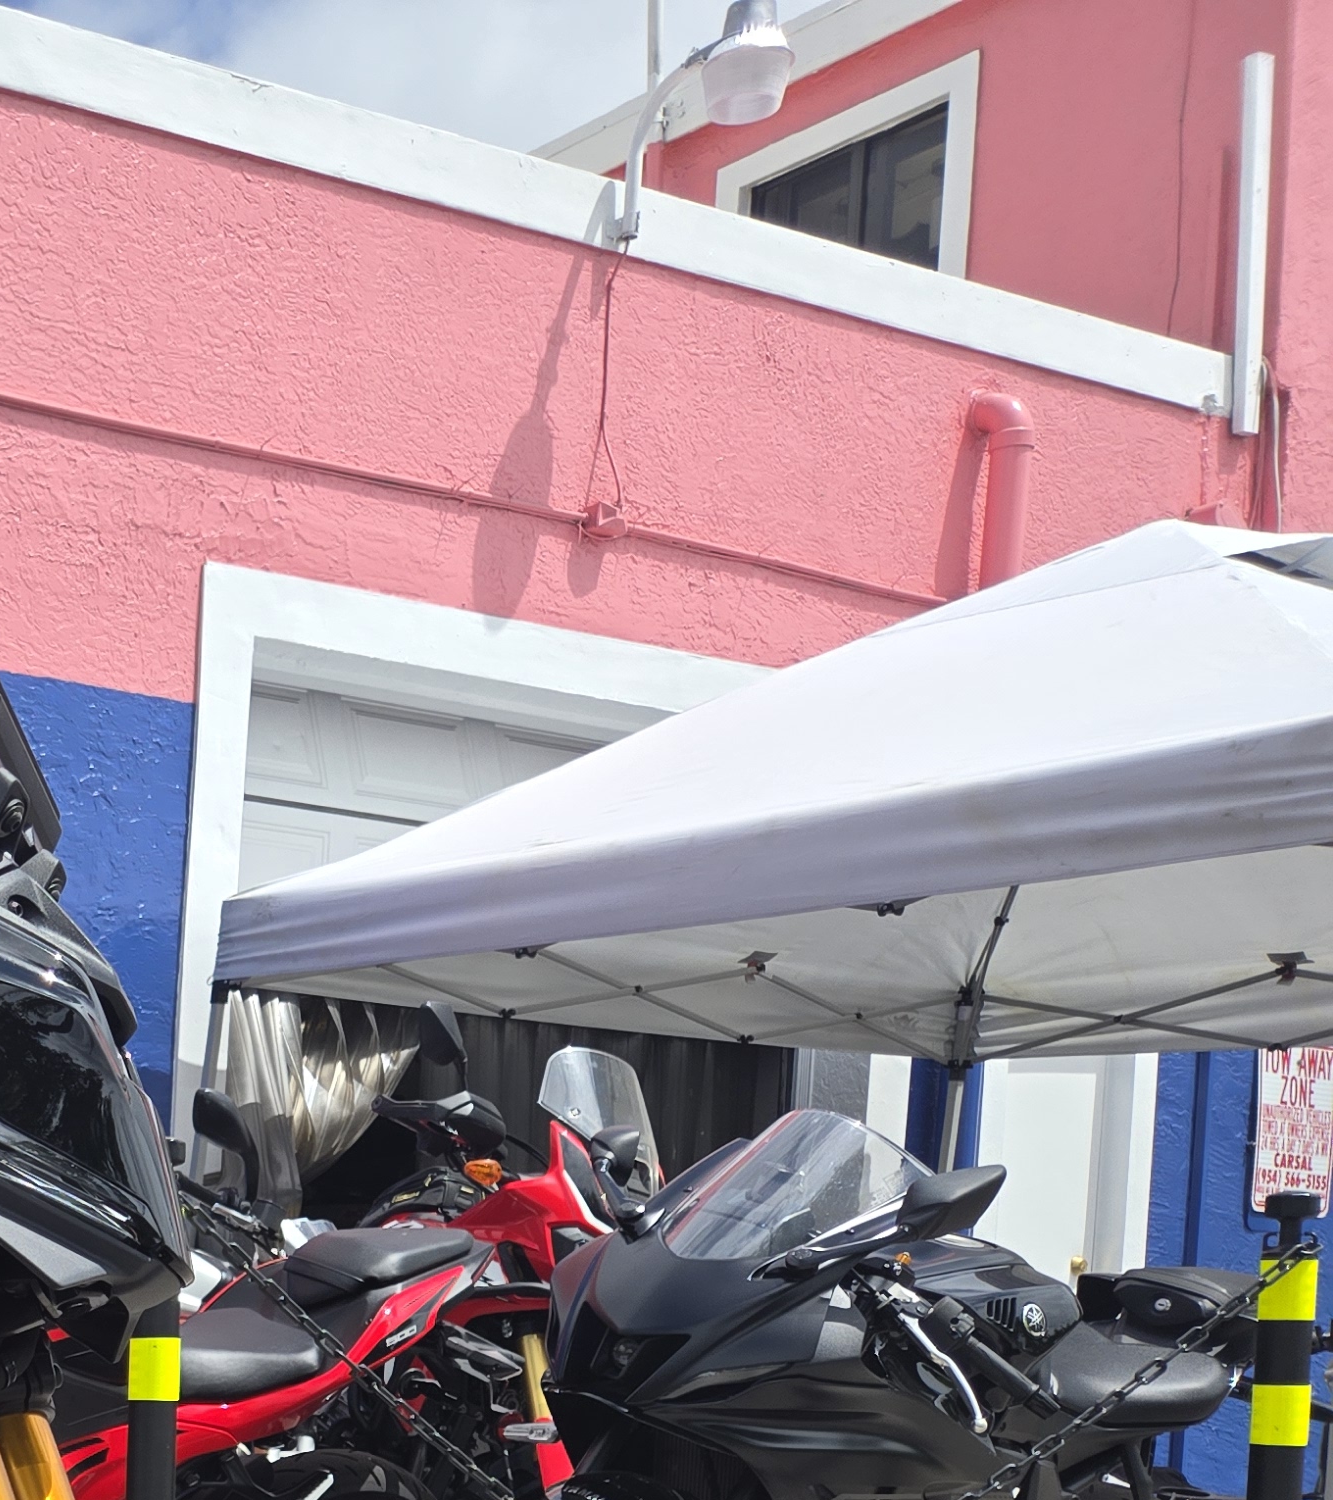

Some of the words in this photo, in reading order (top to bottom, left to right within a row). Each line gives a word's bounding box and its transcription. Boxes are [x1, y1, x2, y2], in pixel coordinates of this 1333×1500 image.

[1263, 1047, 1292, 1075] TOW
[1298, 1045, 1333, 1081] AWAY
[1279, 1075, 1316, 1109] ZONE
[1274, 1152, 1313, 1171] CARSAL
[1257, 1167, 1282, 1187] (954)
[1284, 1171, 1327, 1191] 566-5155
